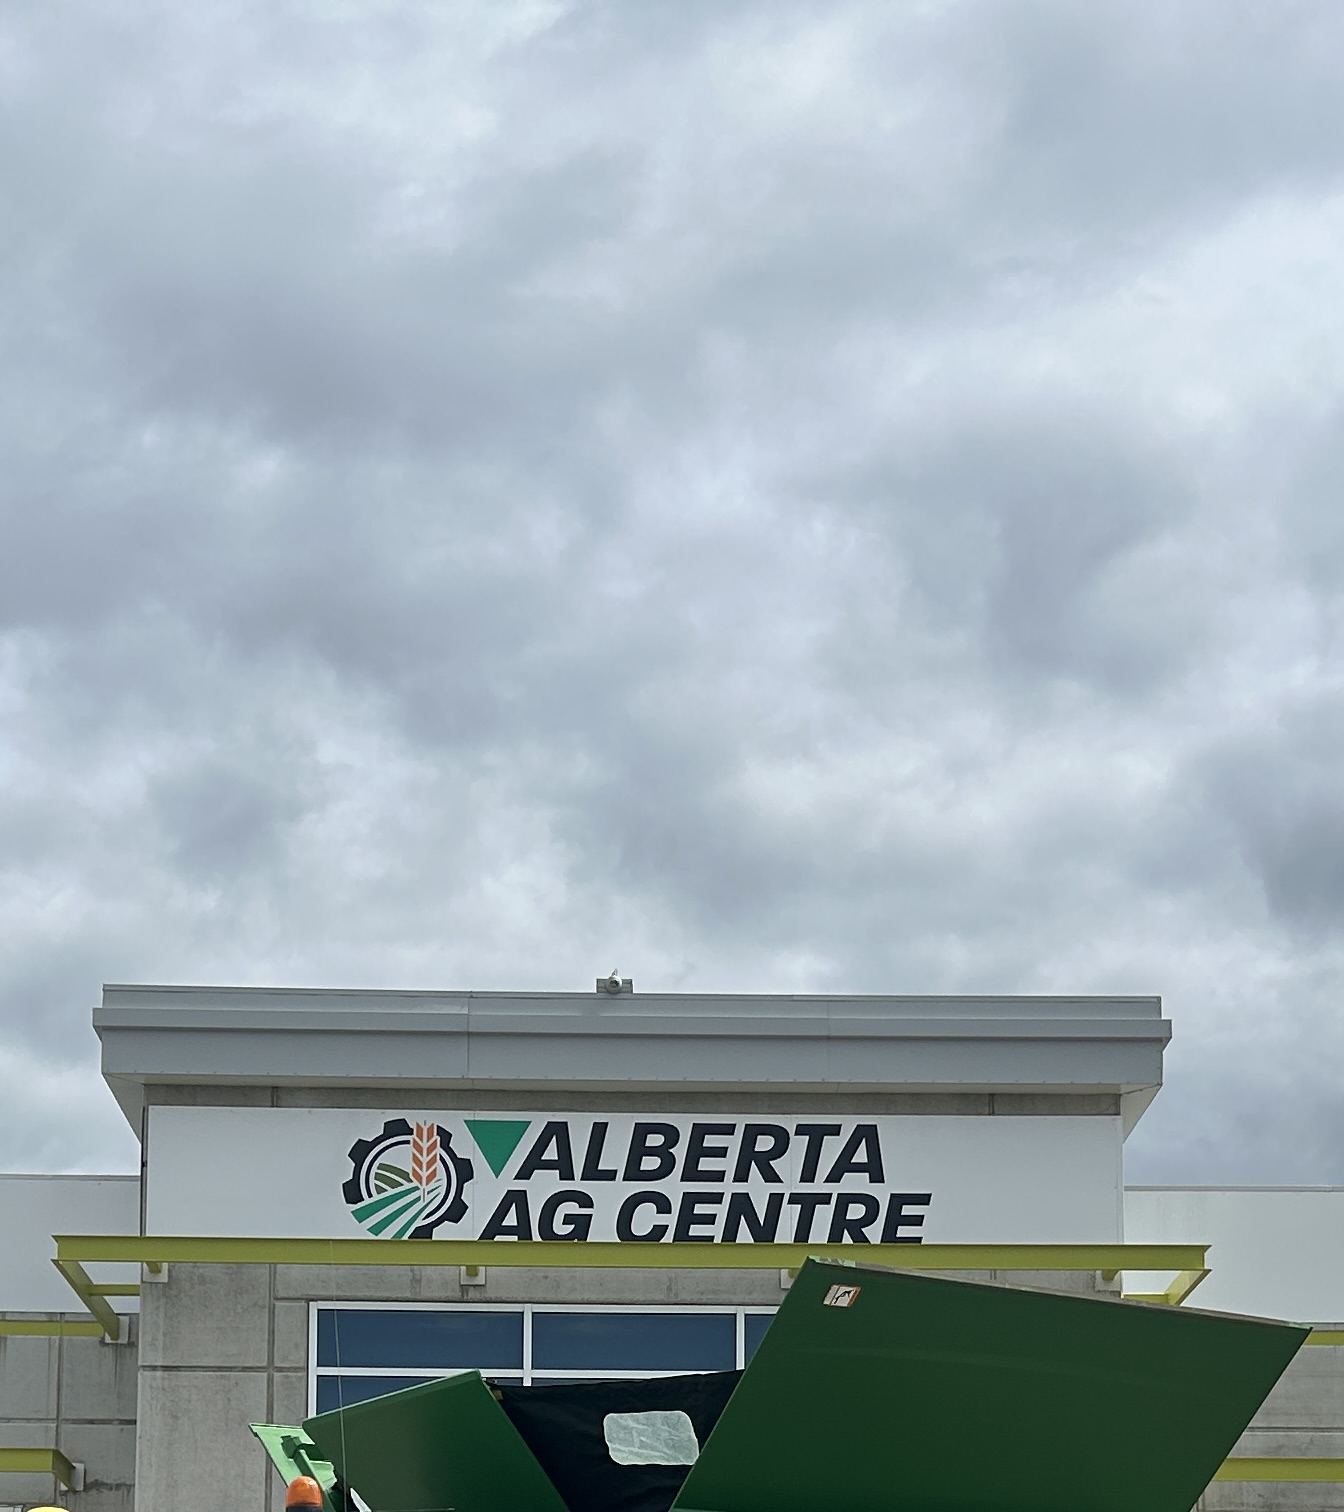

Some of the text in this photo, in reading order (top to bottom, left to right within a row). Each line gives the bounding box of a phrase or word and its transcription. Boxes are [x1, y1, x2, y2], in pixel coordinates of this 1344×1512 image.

[515, 1121, 885, 1184] ALBERTA
[478, 1190, 932, 1244] AG CENTRE
